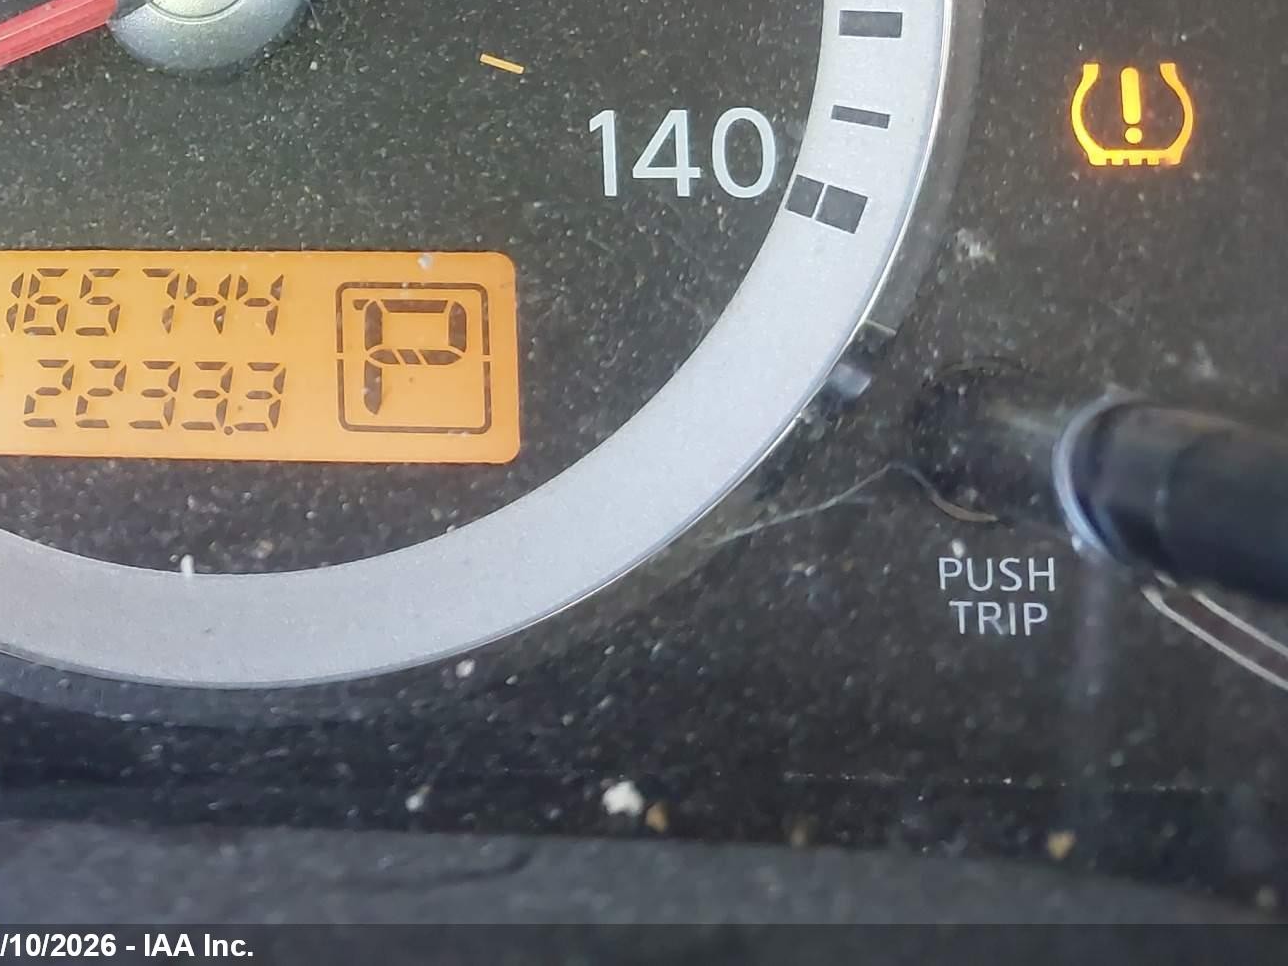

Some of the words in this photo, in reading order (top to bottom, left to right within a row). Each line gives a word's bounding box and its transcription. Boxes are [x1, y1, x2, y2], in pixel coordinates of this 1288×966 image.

[588, 106, 777, 200] 140
[5, 267, 285, 337] 165744
[352, 298, 469, 415] P
[938, 557, 1056, 594] PUSH
[948, 600, 1049, 638] TRIP
